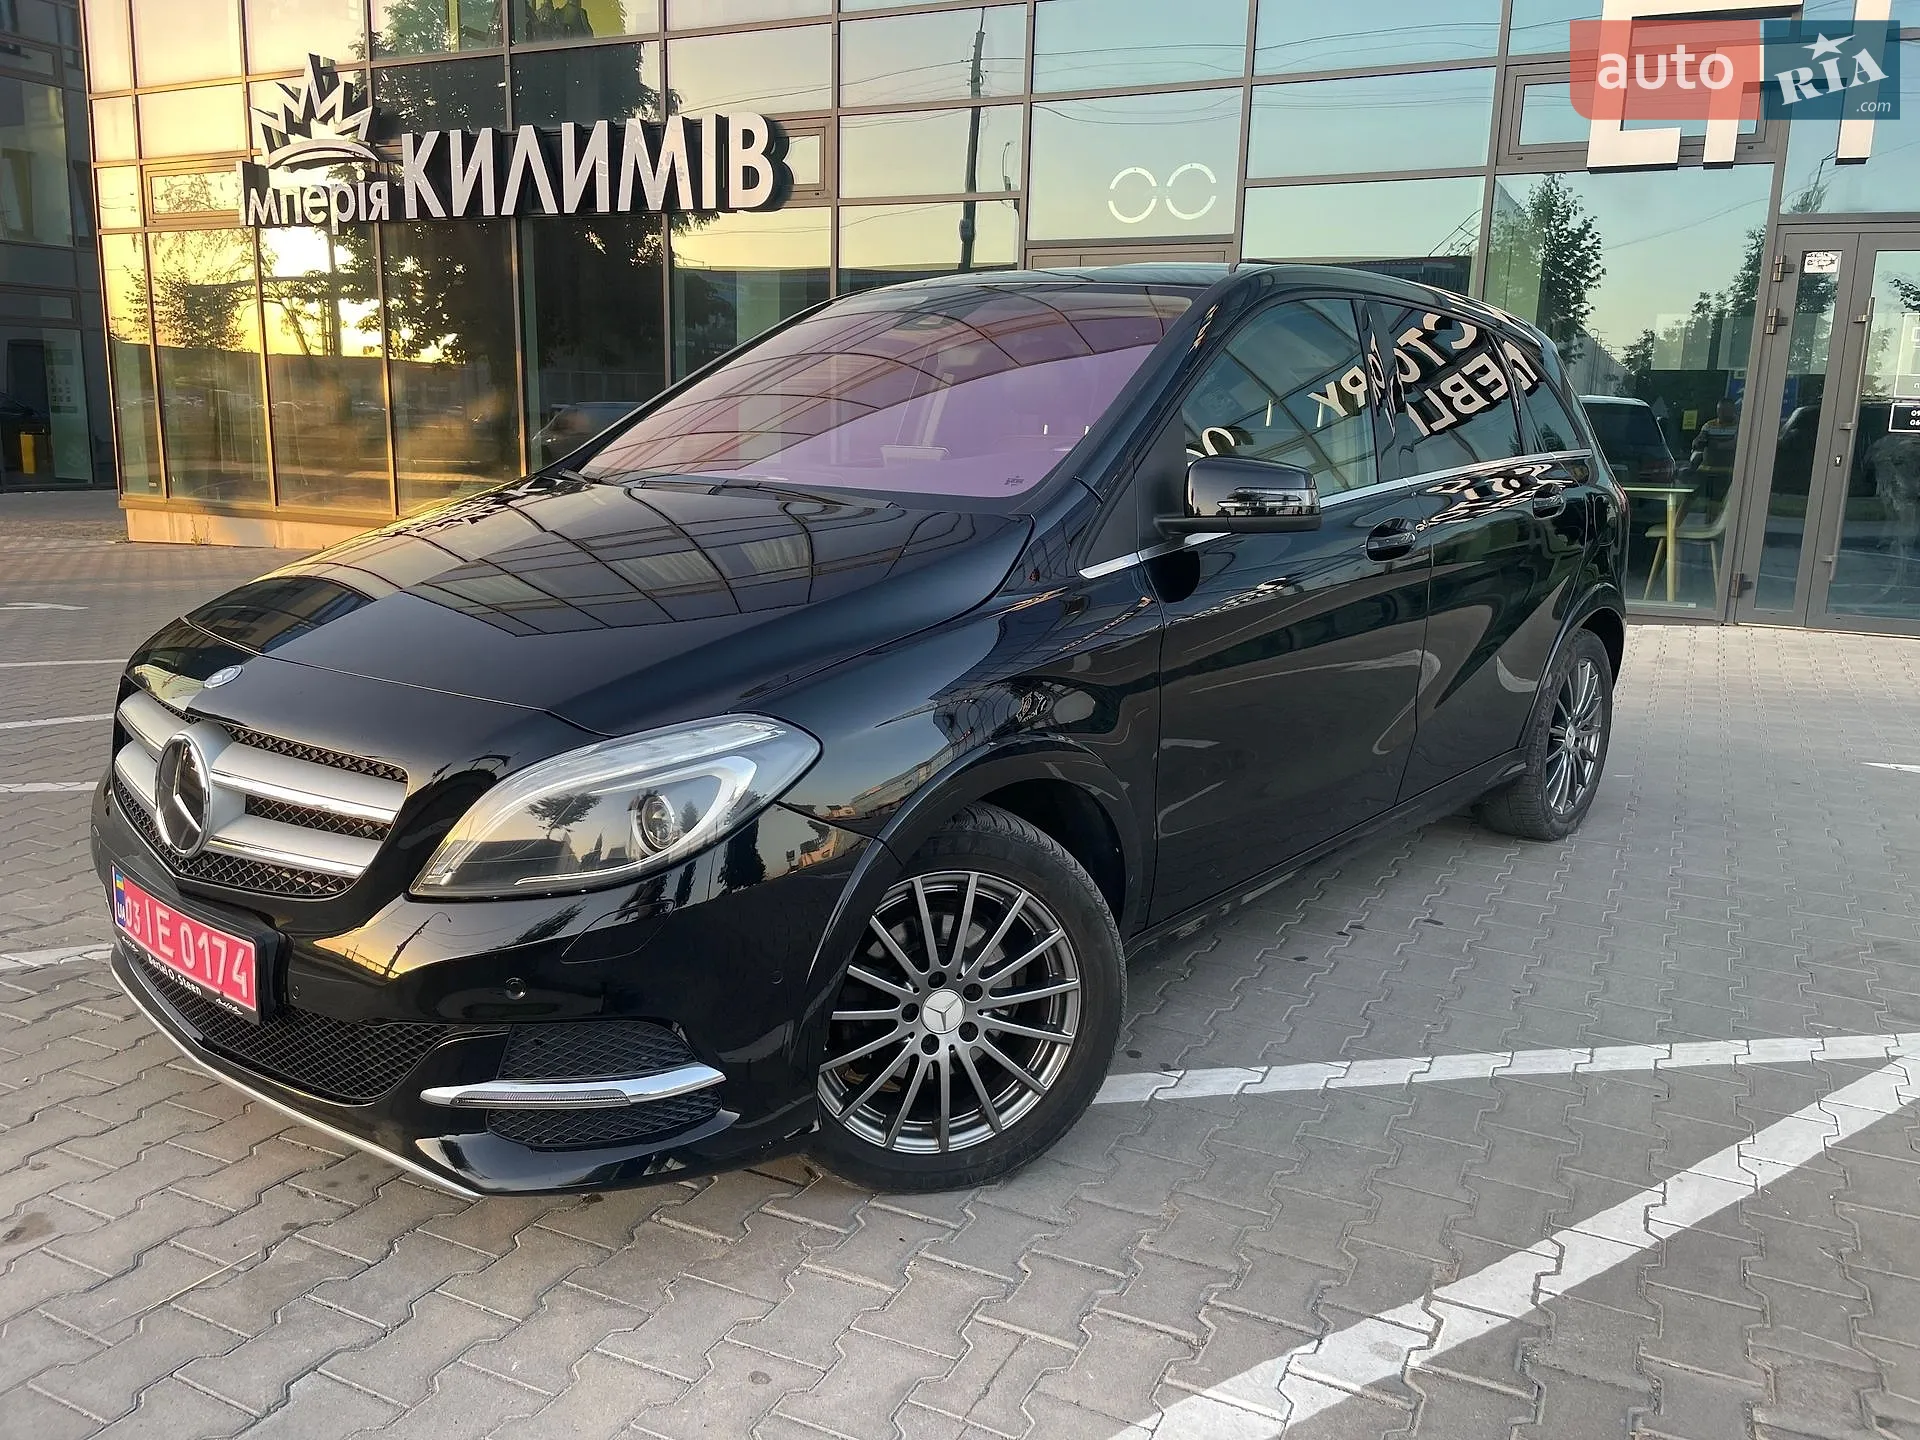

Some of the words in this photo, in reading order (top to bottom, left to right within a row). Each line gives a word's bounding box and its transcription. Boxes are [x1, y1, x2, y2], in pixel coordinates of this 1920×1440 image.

[401, 111, 775, 219] КИЛИМІВ
[117, 903, 125, 921] UA
[180, 922, 248, 998] 0174
[177, 974, 202, 996] Steen
